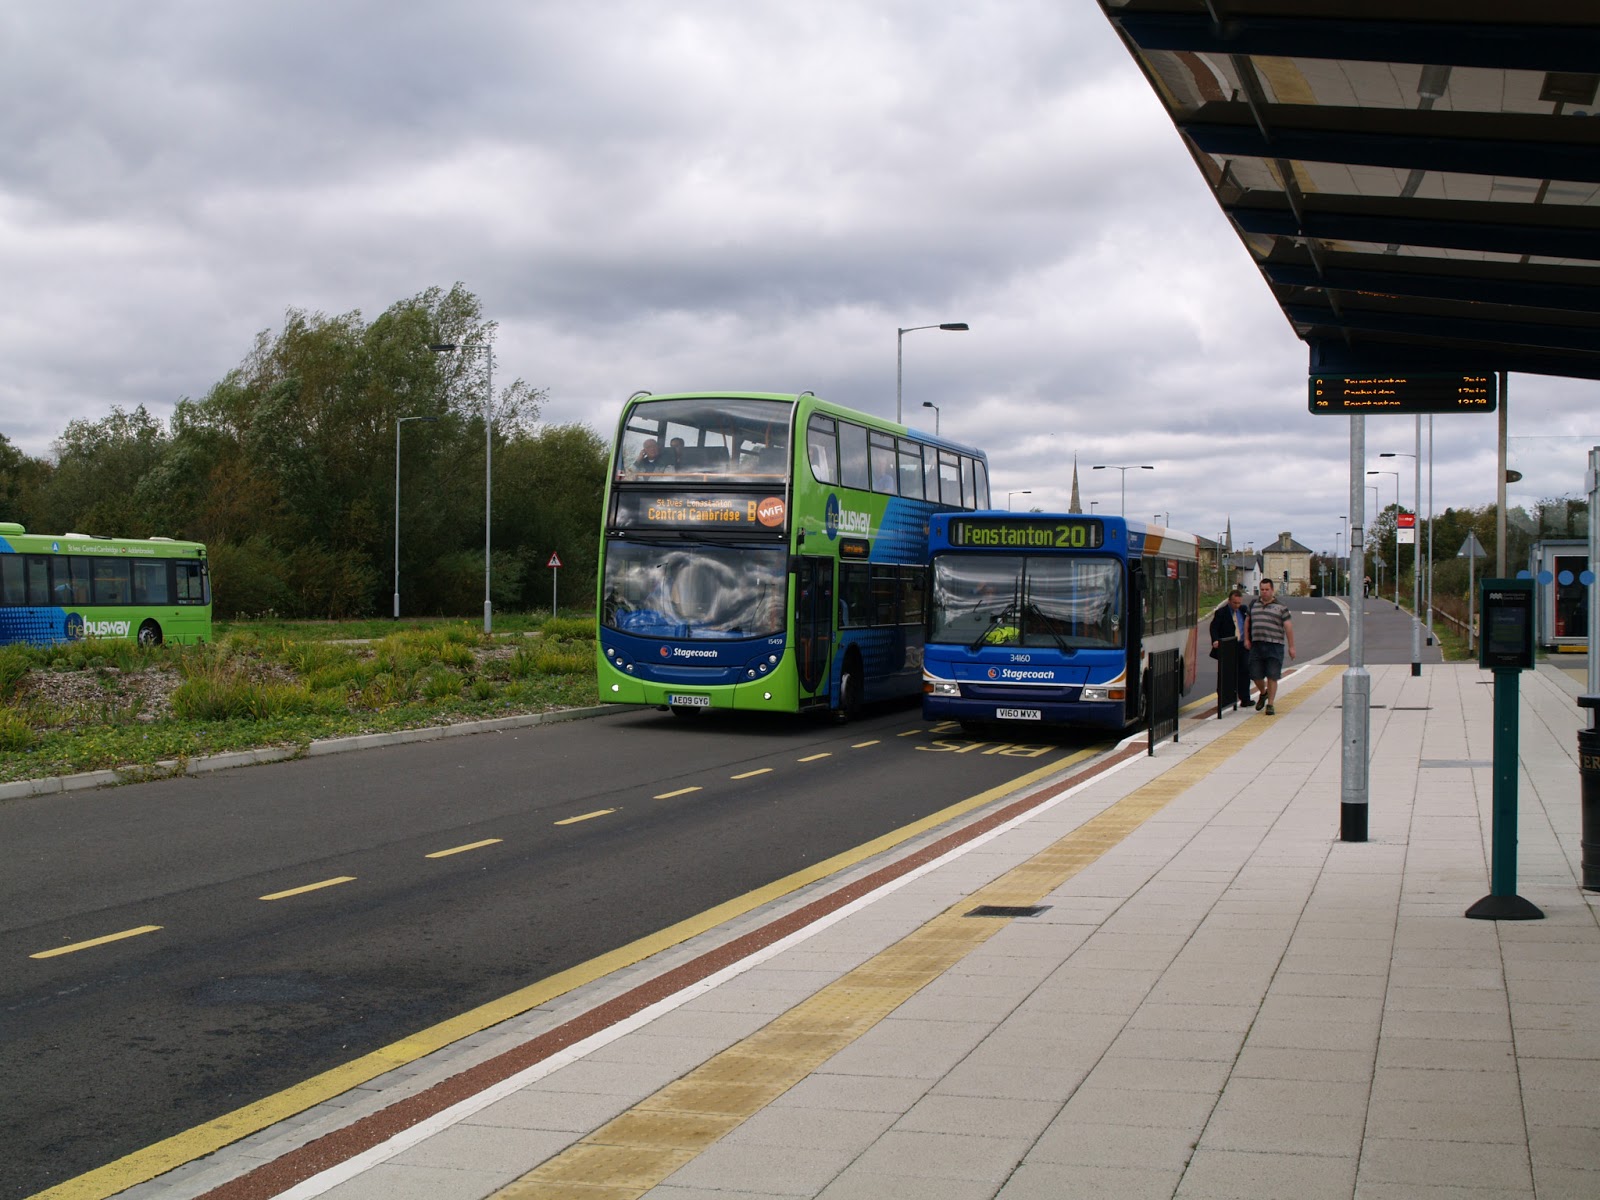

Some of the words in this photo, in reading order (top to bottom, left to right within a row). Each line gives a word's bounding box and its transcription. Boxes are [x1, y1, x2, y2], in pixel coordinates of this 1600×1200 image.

[648, 508, 686, 521] Central
[689, 508, 741, 522] Cambridge
[747, 501, 757, 521] B
[759, 505, 783, 518] WiFi
[964, 524, 1053, 545] Fenstanton
[1055, 525, 1086, 547] 20
[673, 647, 718, 658] Stagecoach
[1010, 654, 1031, 662] 34160
[1001, 668, 1054, 680] Stagecoach
[673, 696, 692, 705] AE09
[693, 697, 709, 705] GYG
[1020, 710, 1038, 719] MVX
